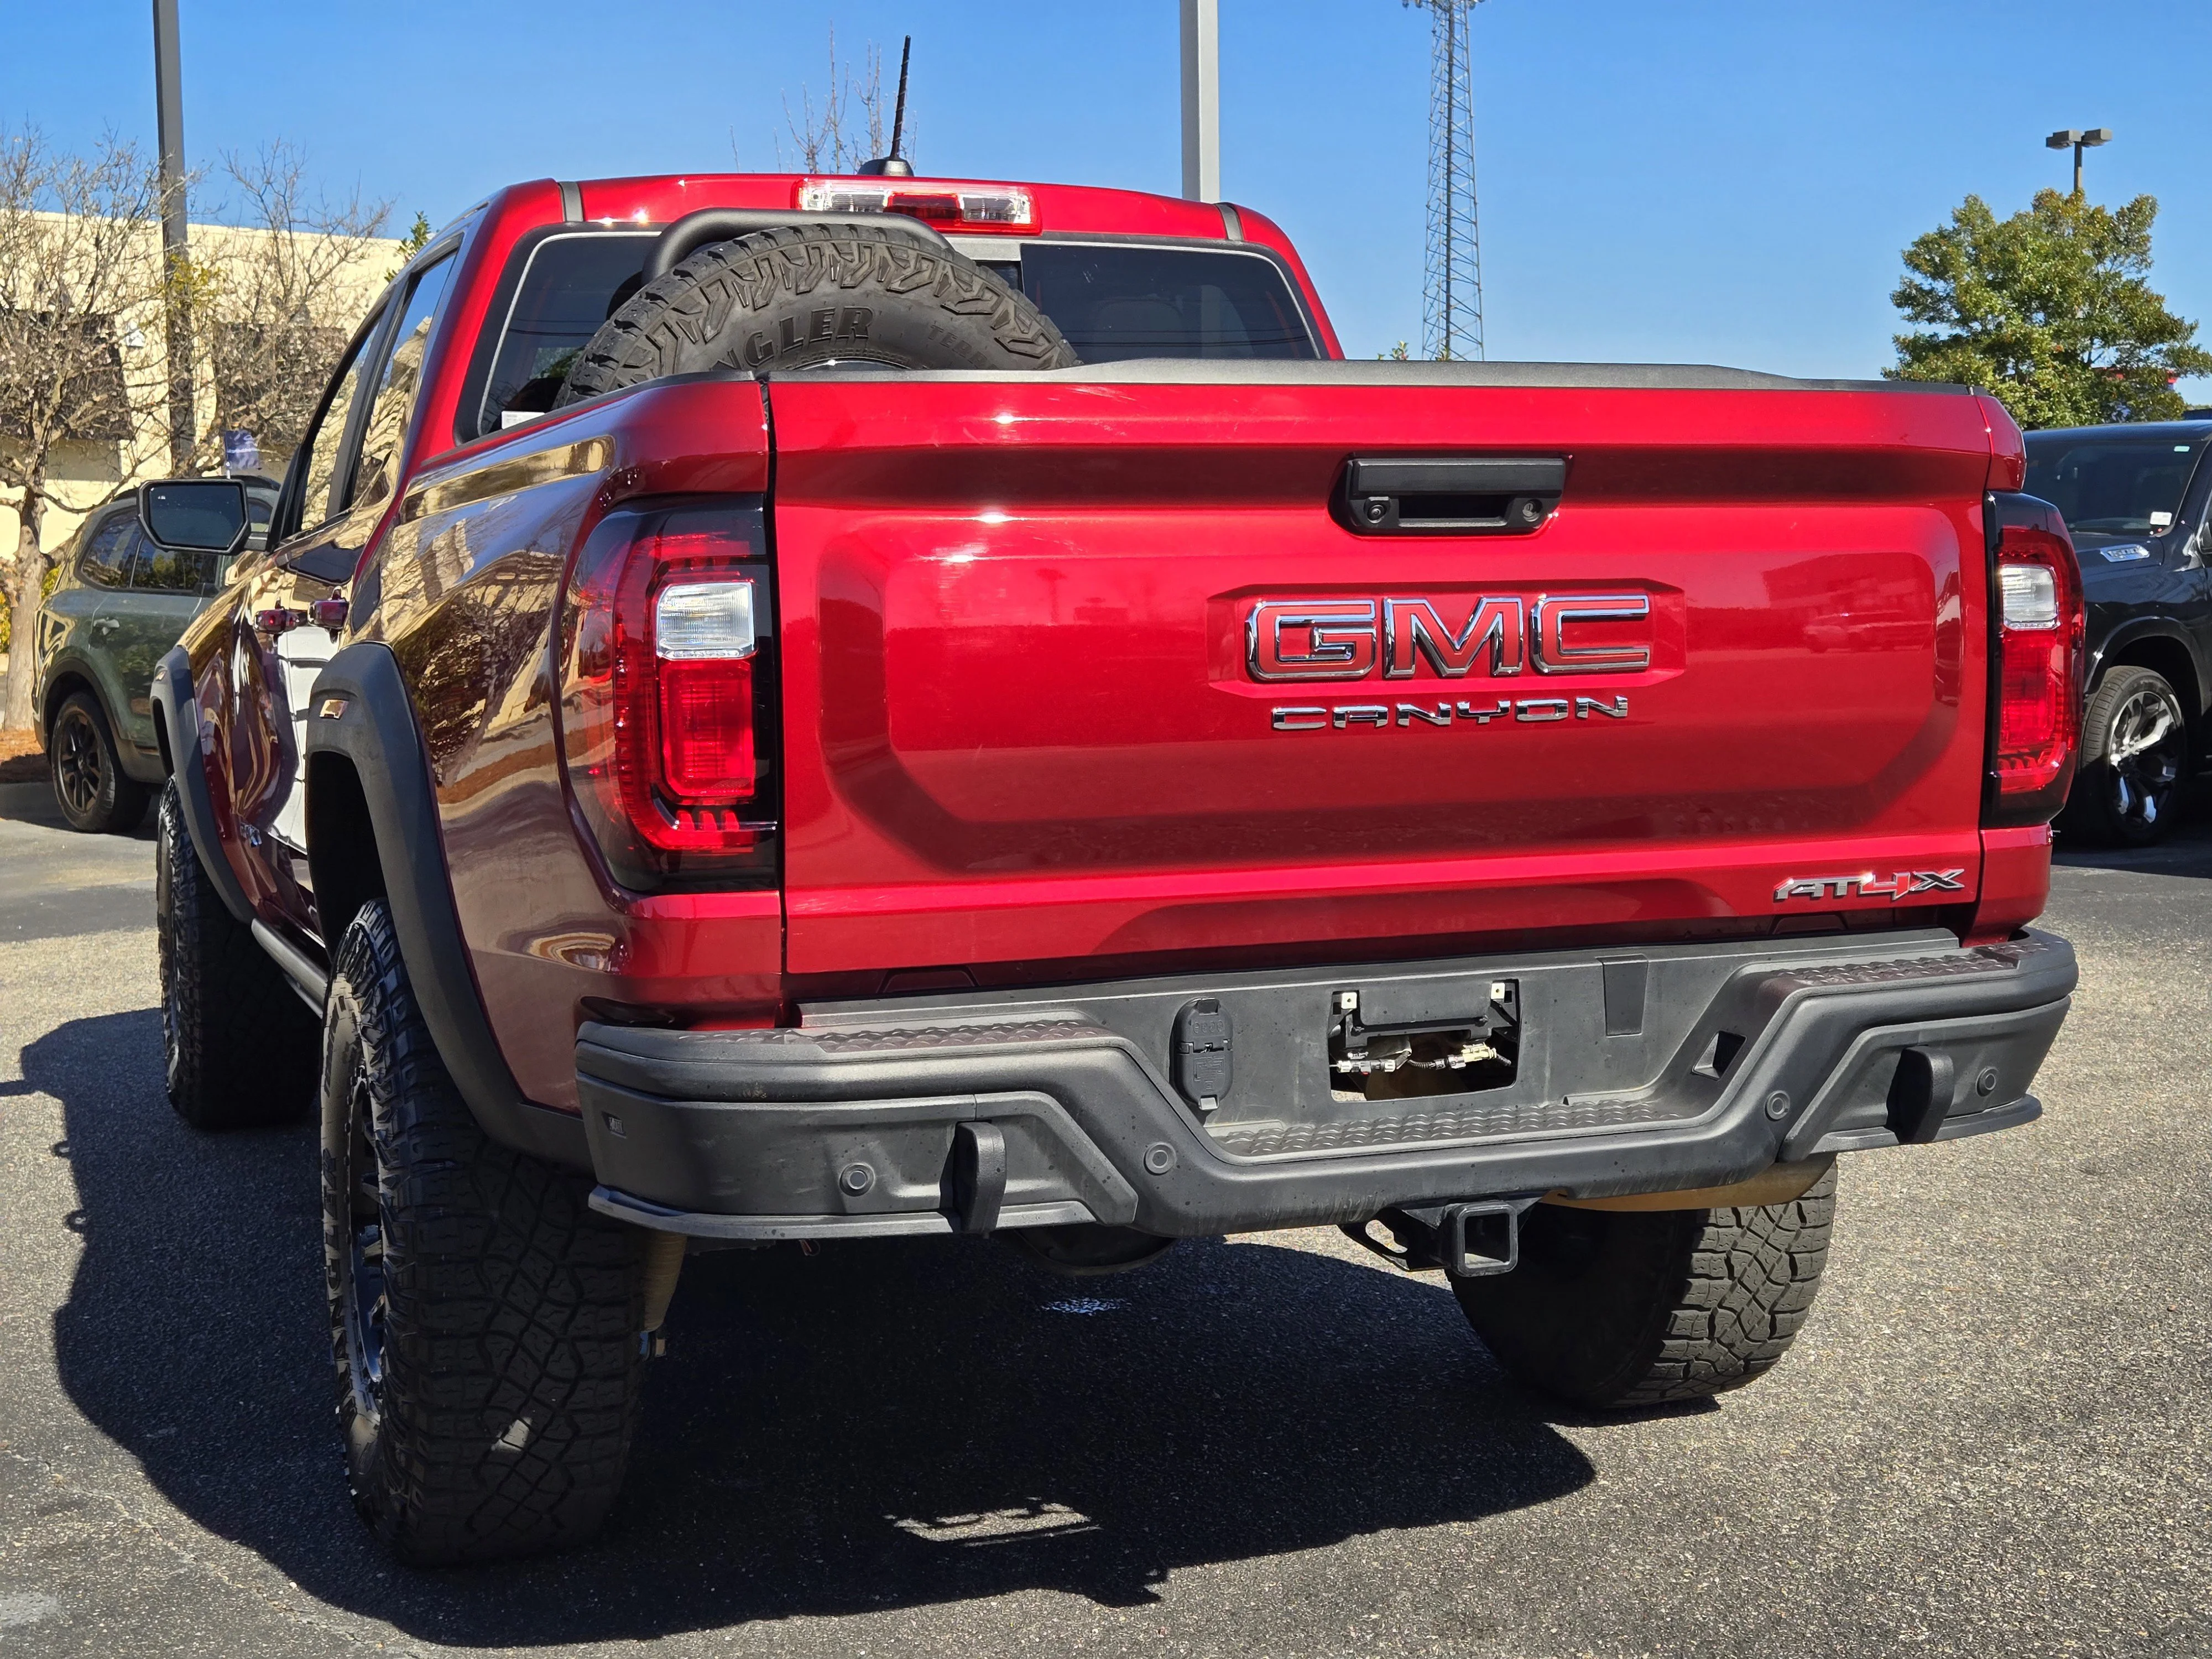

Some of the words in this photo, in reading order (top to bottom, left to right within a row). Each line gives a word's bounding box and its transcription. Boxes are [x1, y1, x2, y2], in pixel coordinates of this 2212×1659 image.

[1245, 594, 1648, 681] GMC
[1272, 696, 1627, 729] CANYON
[1774, 869, 1965, 902] AT4X
